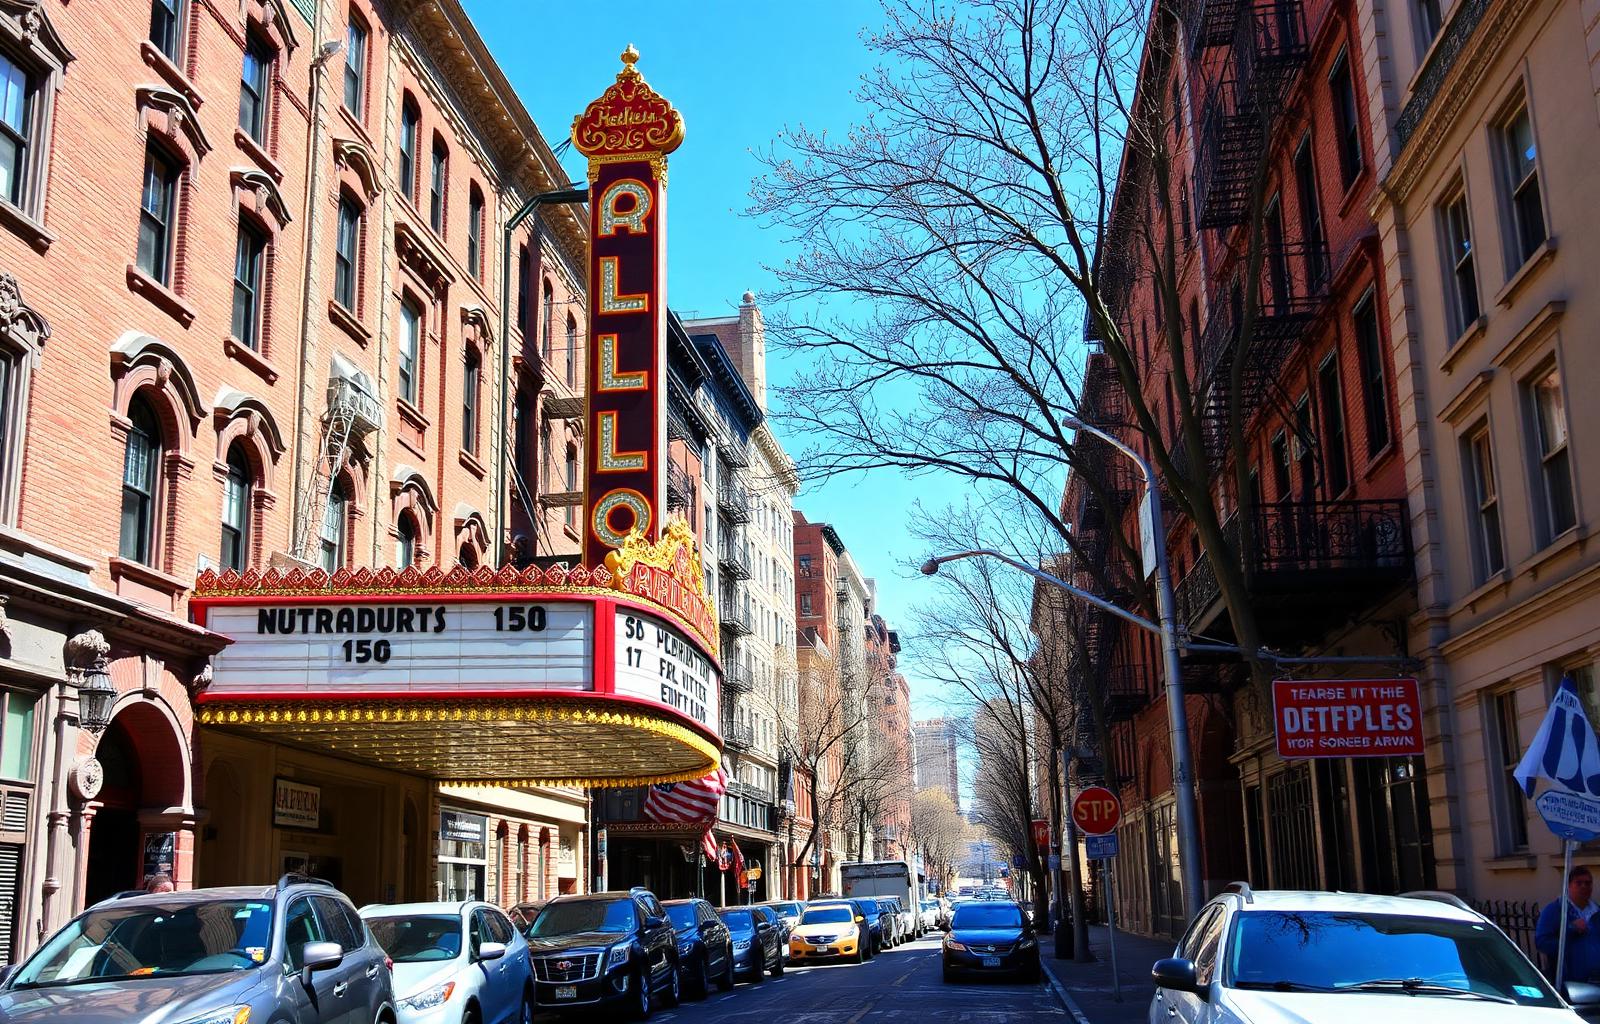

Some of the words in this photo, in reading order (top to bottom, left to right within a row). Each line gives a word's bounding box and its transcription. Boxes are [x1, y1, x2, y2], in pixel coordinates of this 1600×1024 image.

[257, 606, 446, 635] NUTRADURTS
[494, 606, 546, 632] 150
[626, 646, 642, 668] 17
[1283, 703, 1413, 733] DETFPLES
